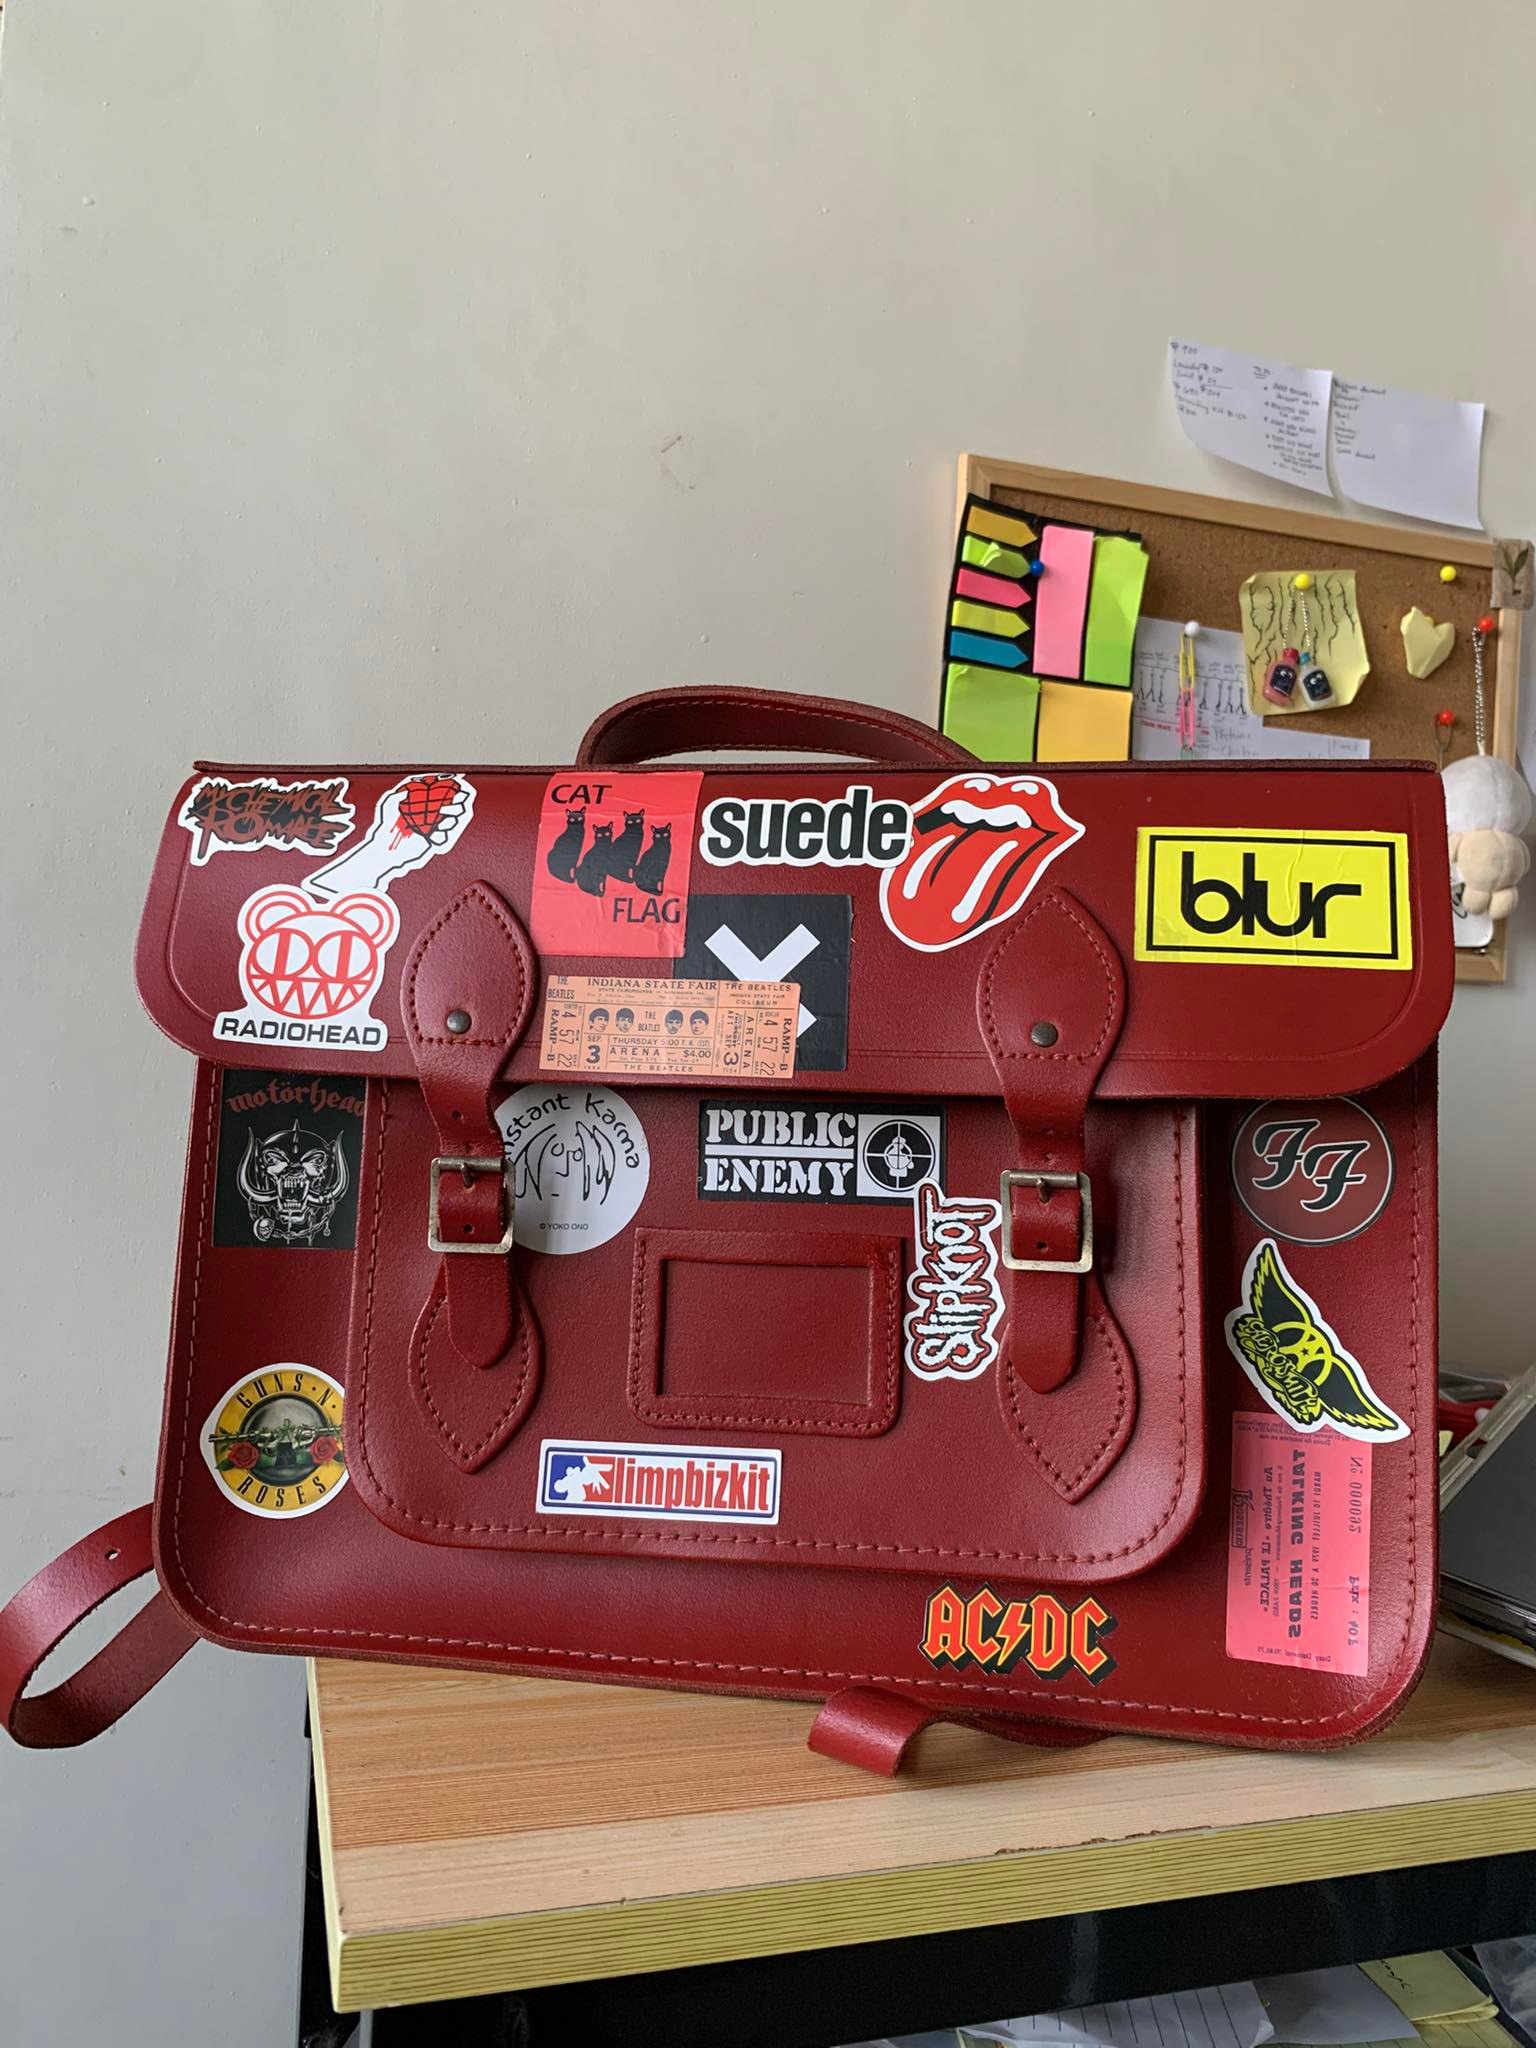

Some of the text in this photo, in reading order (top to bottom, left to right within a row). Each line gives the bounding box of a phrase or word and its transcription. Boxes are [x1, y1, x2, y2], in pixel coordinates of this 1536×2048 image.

[551, 784, 612, 804] CAT
[707, 788, 908, 860] suede
[1180, 850, 1362, 939] blur
[612, 897, 681, 923] FLAG
[587, 978, 717, 990] INDIANA STATE FAIR
[725, 983, 791, 992] THE BEATLES
[548, 989, 575, 1000] BEATLES
[645, 1011, 657, 1019] THE
[220, 1017, 381, 1046] RADIOHEAD
[638, 1023, 660, 1032] BEATLES
[559, 1029, 575, 1045] 57
[612, 1037, 658, 1045] THURSDAY
[742, 1016, 754, 1069] ARENA
[762, 1036, 777, 1052] 57
[557, 1053, 572, 1068] 22
[586, 1045, 601, 1064] 3
[610, 1048, 712, 1059] ARENA $4.00
[723, 1052, 739, 1066] 3
[623, 1063, 641, 1071] THE
[760, 1061, 776, 1077] 22
[585, 1092, 640, 1169] Karma
[705, 1109, 857, 1148] PUBLIC
[703, 1158, 854, 1196] ENEMY
[547, 1223, 569, 1231] YOKO
[571, 1223, 589, 1231] ONO
[236, 1373, 304, 1409] GUNS
[237, 1475, 327, 1507] ROSES
[614, 1457, 770, 1511] limpbizkit
